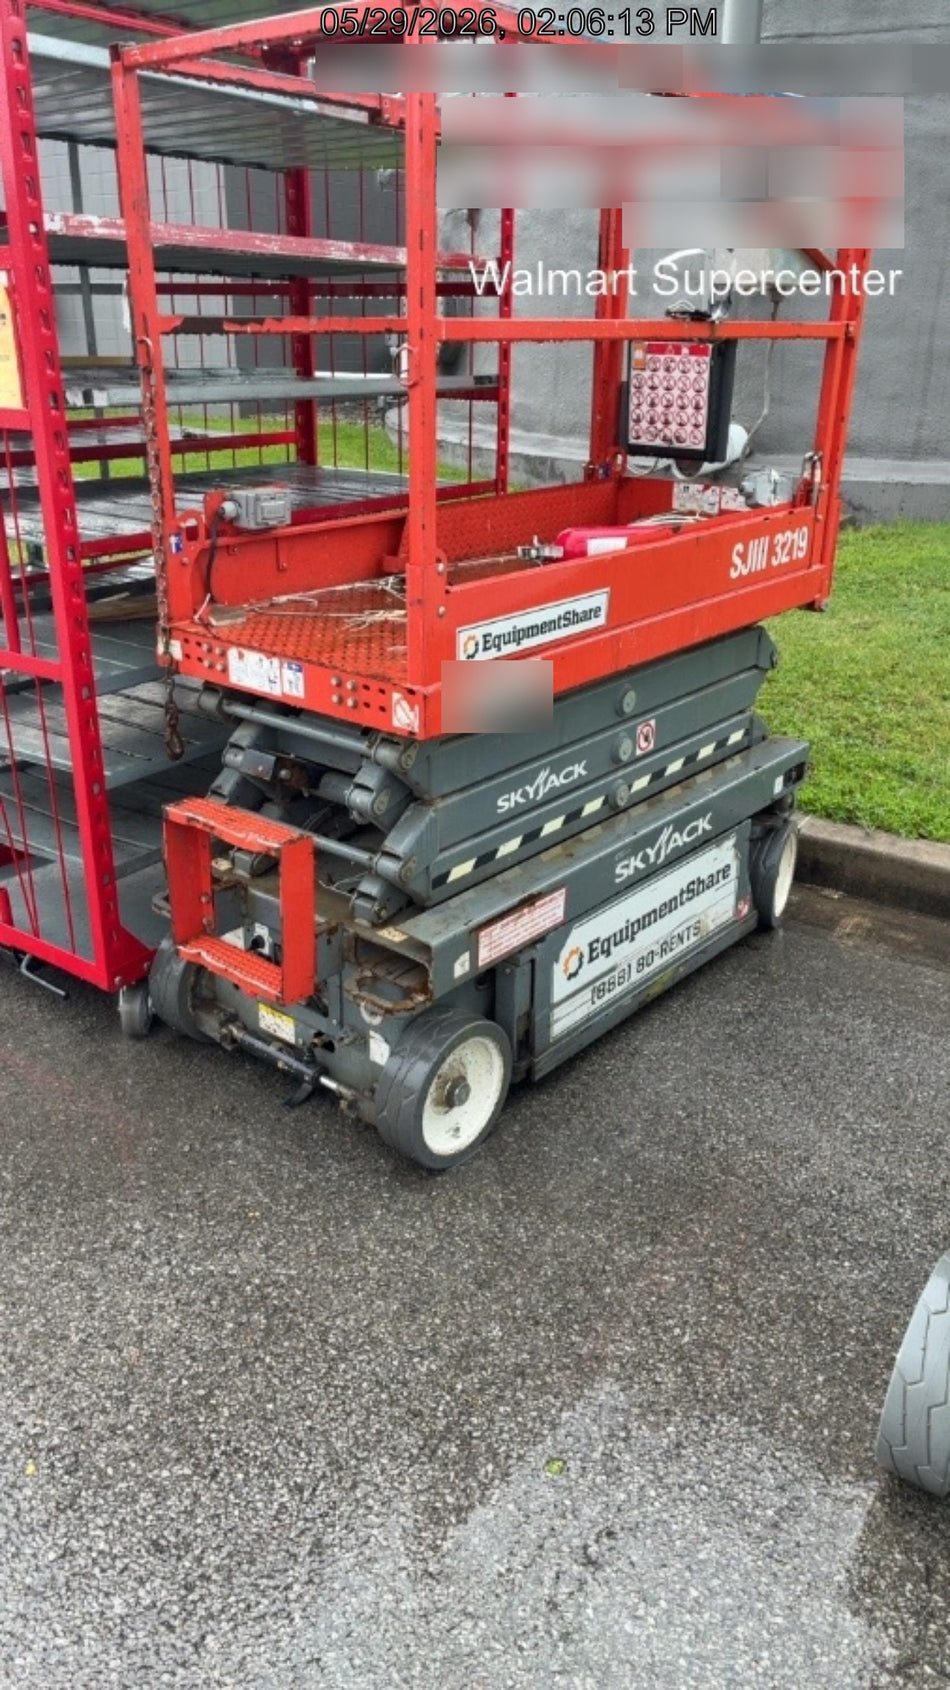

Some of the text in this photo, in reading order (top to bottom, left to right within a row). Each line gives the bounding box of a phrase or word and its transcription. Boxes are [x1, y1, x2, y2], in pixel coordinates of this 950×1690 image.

[771, 526, 808, 567] 3219
[481, 605, 602, 653] EquipmentShare
[497, 760, 588, 813] SKYJACK
[614, 812, 713, 883] SKYJACK
[587, 863, 732, 964] EquipmentShare
[636, 919, 702, 973] 80-RENTS
